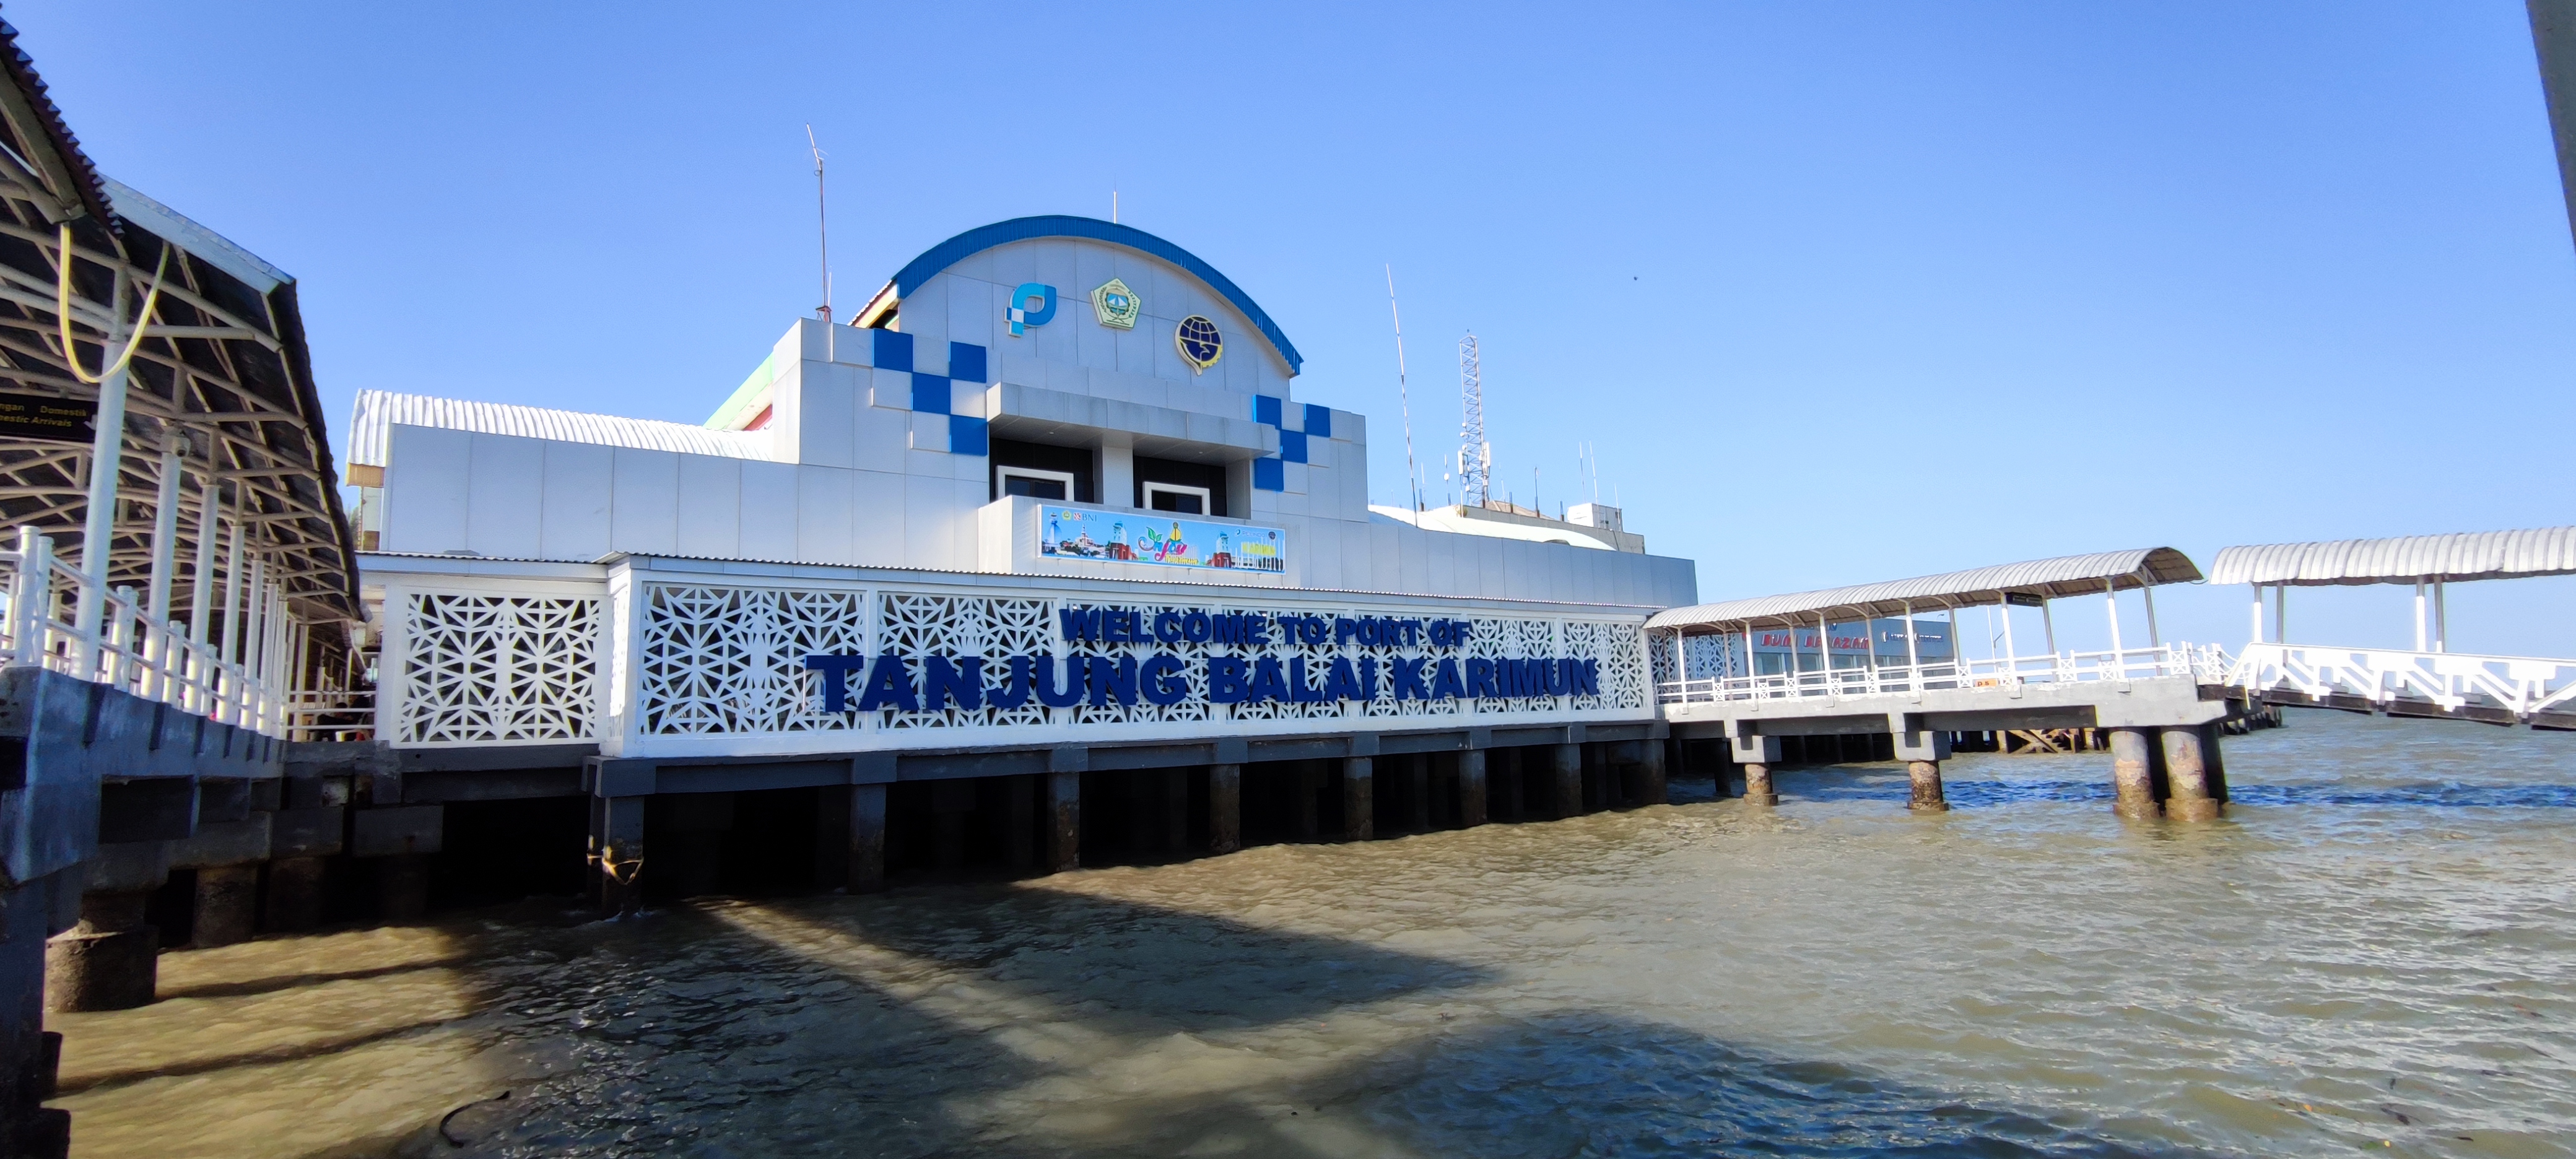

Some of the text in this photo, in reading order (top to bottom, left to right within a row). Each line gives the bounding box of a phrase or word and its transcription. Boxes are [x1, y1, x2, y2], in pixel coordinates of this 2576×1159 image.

[40, 406, 87, 417] Domestik
[31, 417, 72, 427] Arrivals
[1082, 513, 1097, 522] BNI
[1059, 609, 1470, 648] WELCOME TO PORT OF
[1804, 635, 1869, 650] BEAZAM
[806, 654, 1599, 712] TANJUNG BALAI KARIMUN
